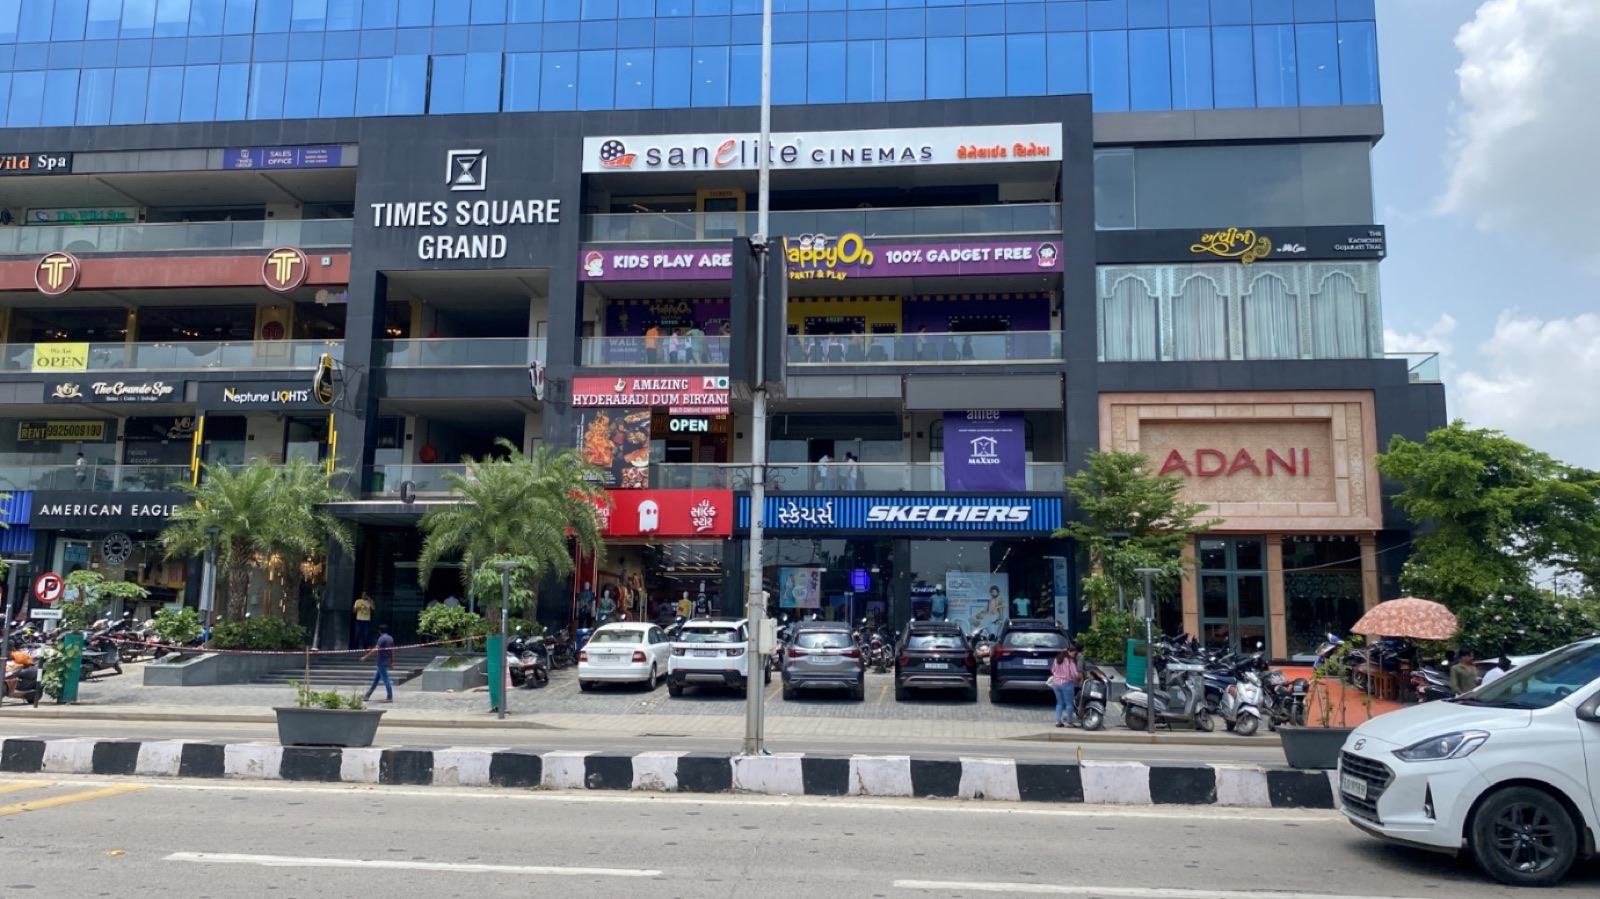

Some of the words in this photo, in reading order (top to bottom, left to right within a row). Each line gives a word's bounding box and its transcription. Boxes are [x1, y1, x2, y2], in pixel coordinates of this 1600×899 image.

[646, 139, 798, 167] sanelite
[811, 146, 932, 163] CINEMAS
[37, 154, 66, 170] Spa
[371, 201, 448, 227] TIMES
[455, 199, 560, 226] SQUARE
[417, 235, 507, 260] GRAND
[886, 250, 922, 264] 100%
[926, 248, 991, 262] GADGET
[994, 247, 1032, 260] FREE
[614, 256, 649, 269] KIDS
[653, 254, 695, 268] PLAY
[699, 253, 732, 267] ARE
[789, 271, 815, 279] PARTY
[827, 270, 847, 280] PLAY
[609, 338, 638, 346] WALL
[37, 357, 84, 368] OPEN
[633, 379, 689, 390] AMAZING
[223, 387, 270, 404] Neptune
[573, 394, 649, 405] HYDERABADI
[652, 394, 680, 405] DUM
[682, 394, 728, 405] BIRYANI
[669, 418, 708, 432] OPEN
[21, 428, 46, 439] RENT
[1159, 448, 1310, 477] ADANI
[39, 504, 123, 516] AMERICAN
[131, 504, 178, 516] EAGLE
[866, 505, 1031, 522] SKECHERS
